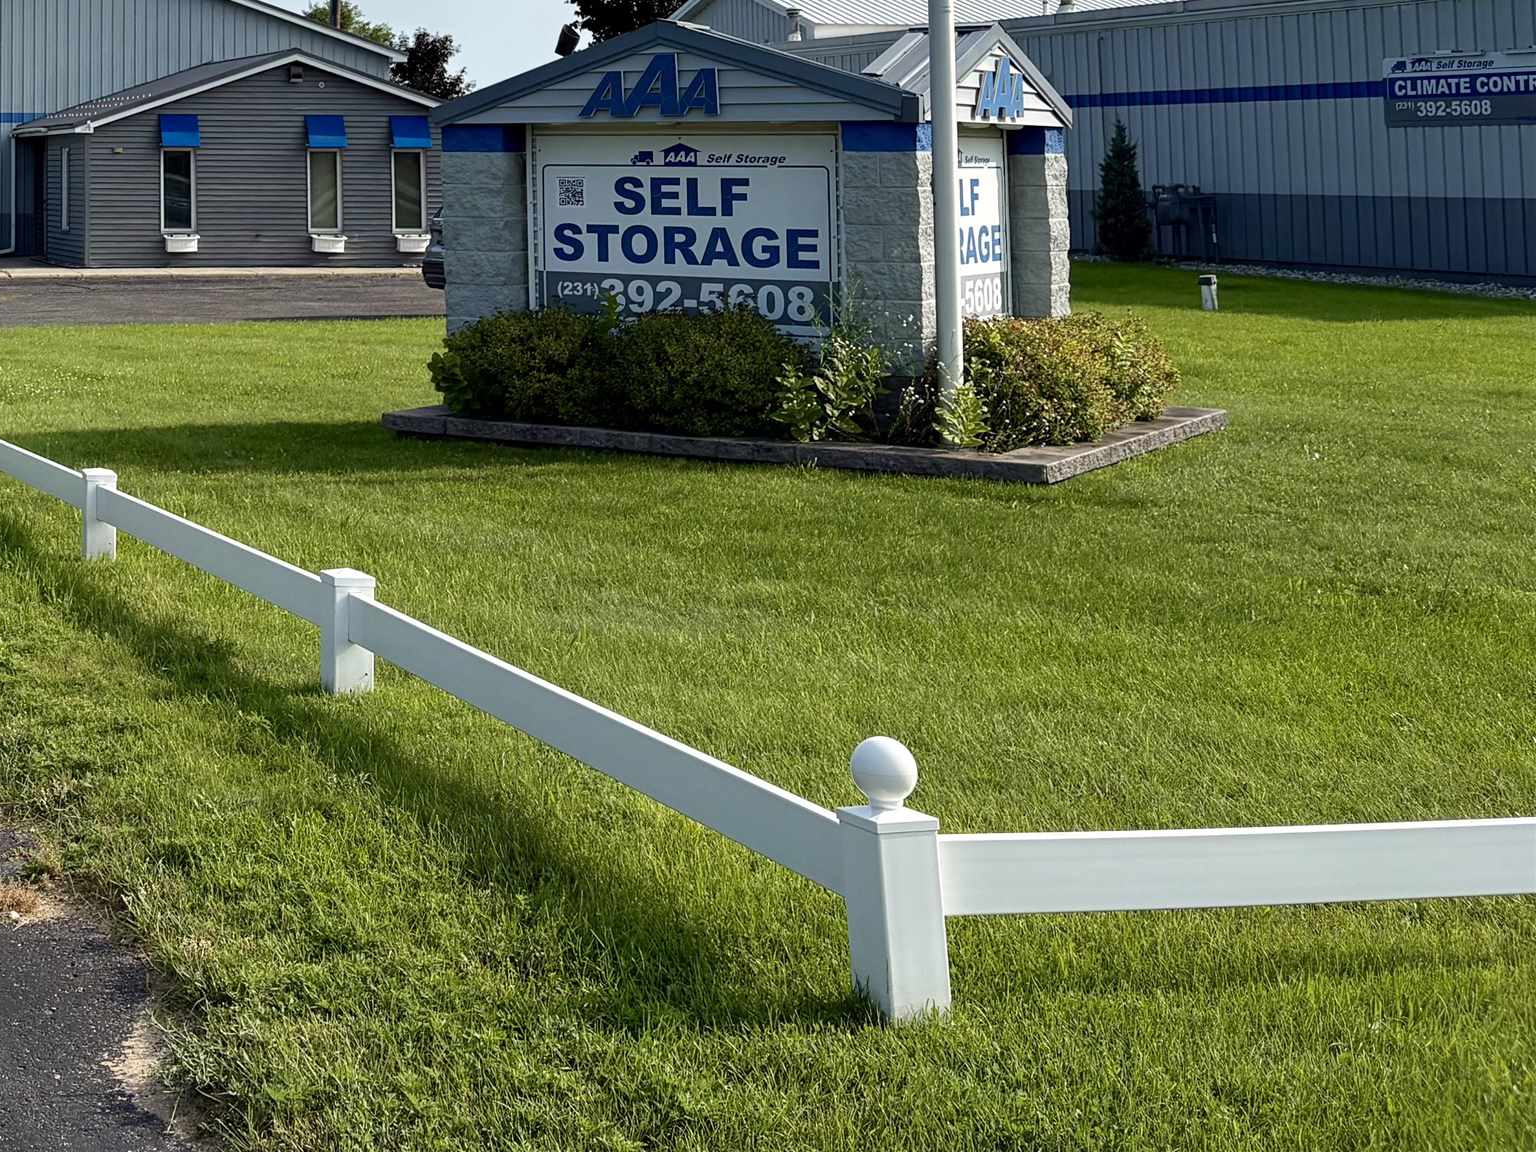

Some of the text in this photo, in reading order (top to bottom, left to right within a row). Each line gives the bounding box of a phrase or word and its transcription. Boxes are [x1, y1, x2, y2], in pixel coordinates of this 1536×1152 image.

[1435, 60, 1456, 70] Self
[1457, 59, 1494, 69] Storage
[578, 52, 721, 118] AAA
[975, 56, 1024, 118] AAA
[1394, 77, 1471, 96] CLIMATE
[1395, 99, 1492, 117] (231) 392-5608
[664, 151, 787, 166] AAA Self Storage
[613, 176, 751, 217] SELF
[959, 178, 980, 217] LF
[553, 222, 821, 270] STORAGE
[557, 280, 599, 300] (231)
[961, 277, 1002, 314] -5608
